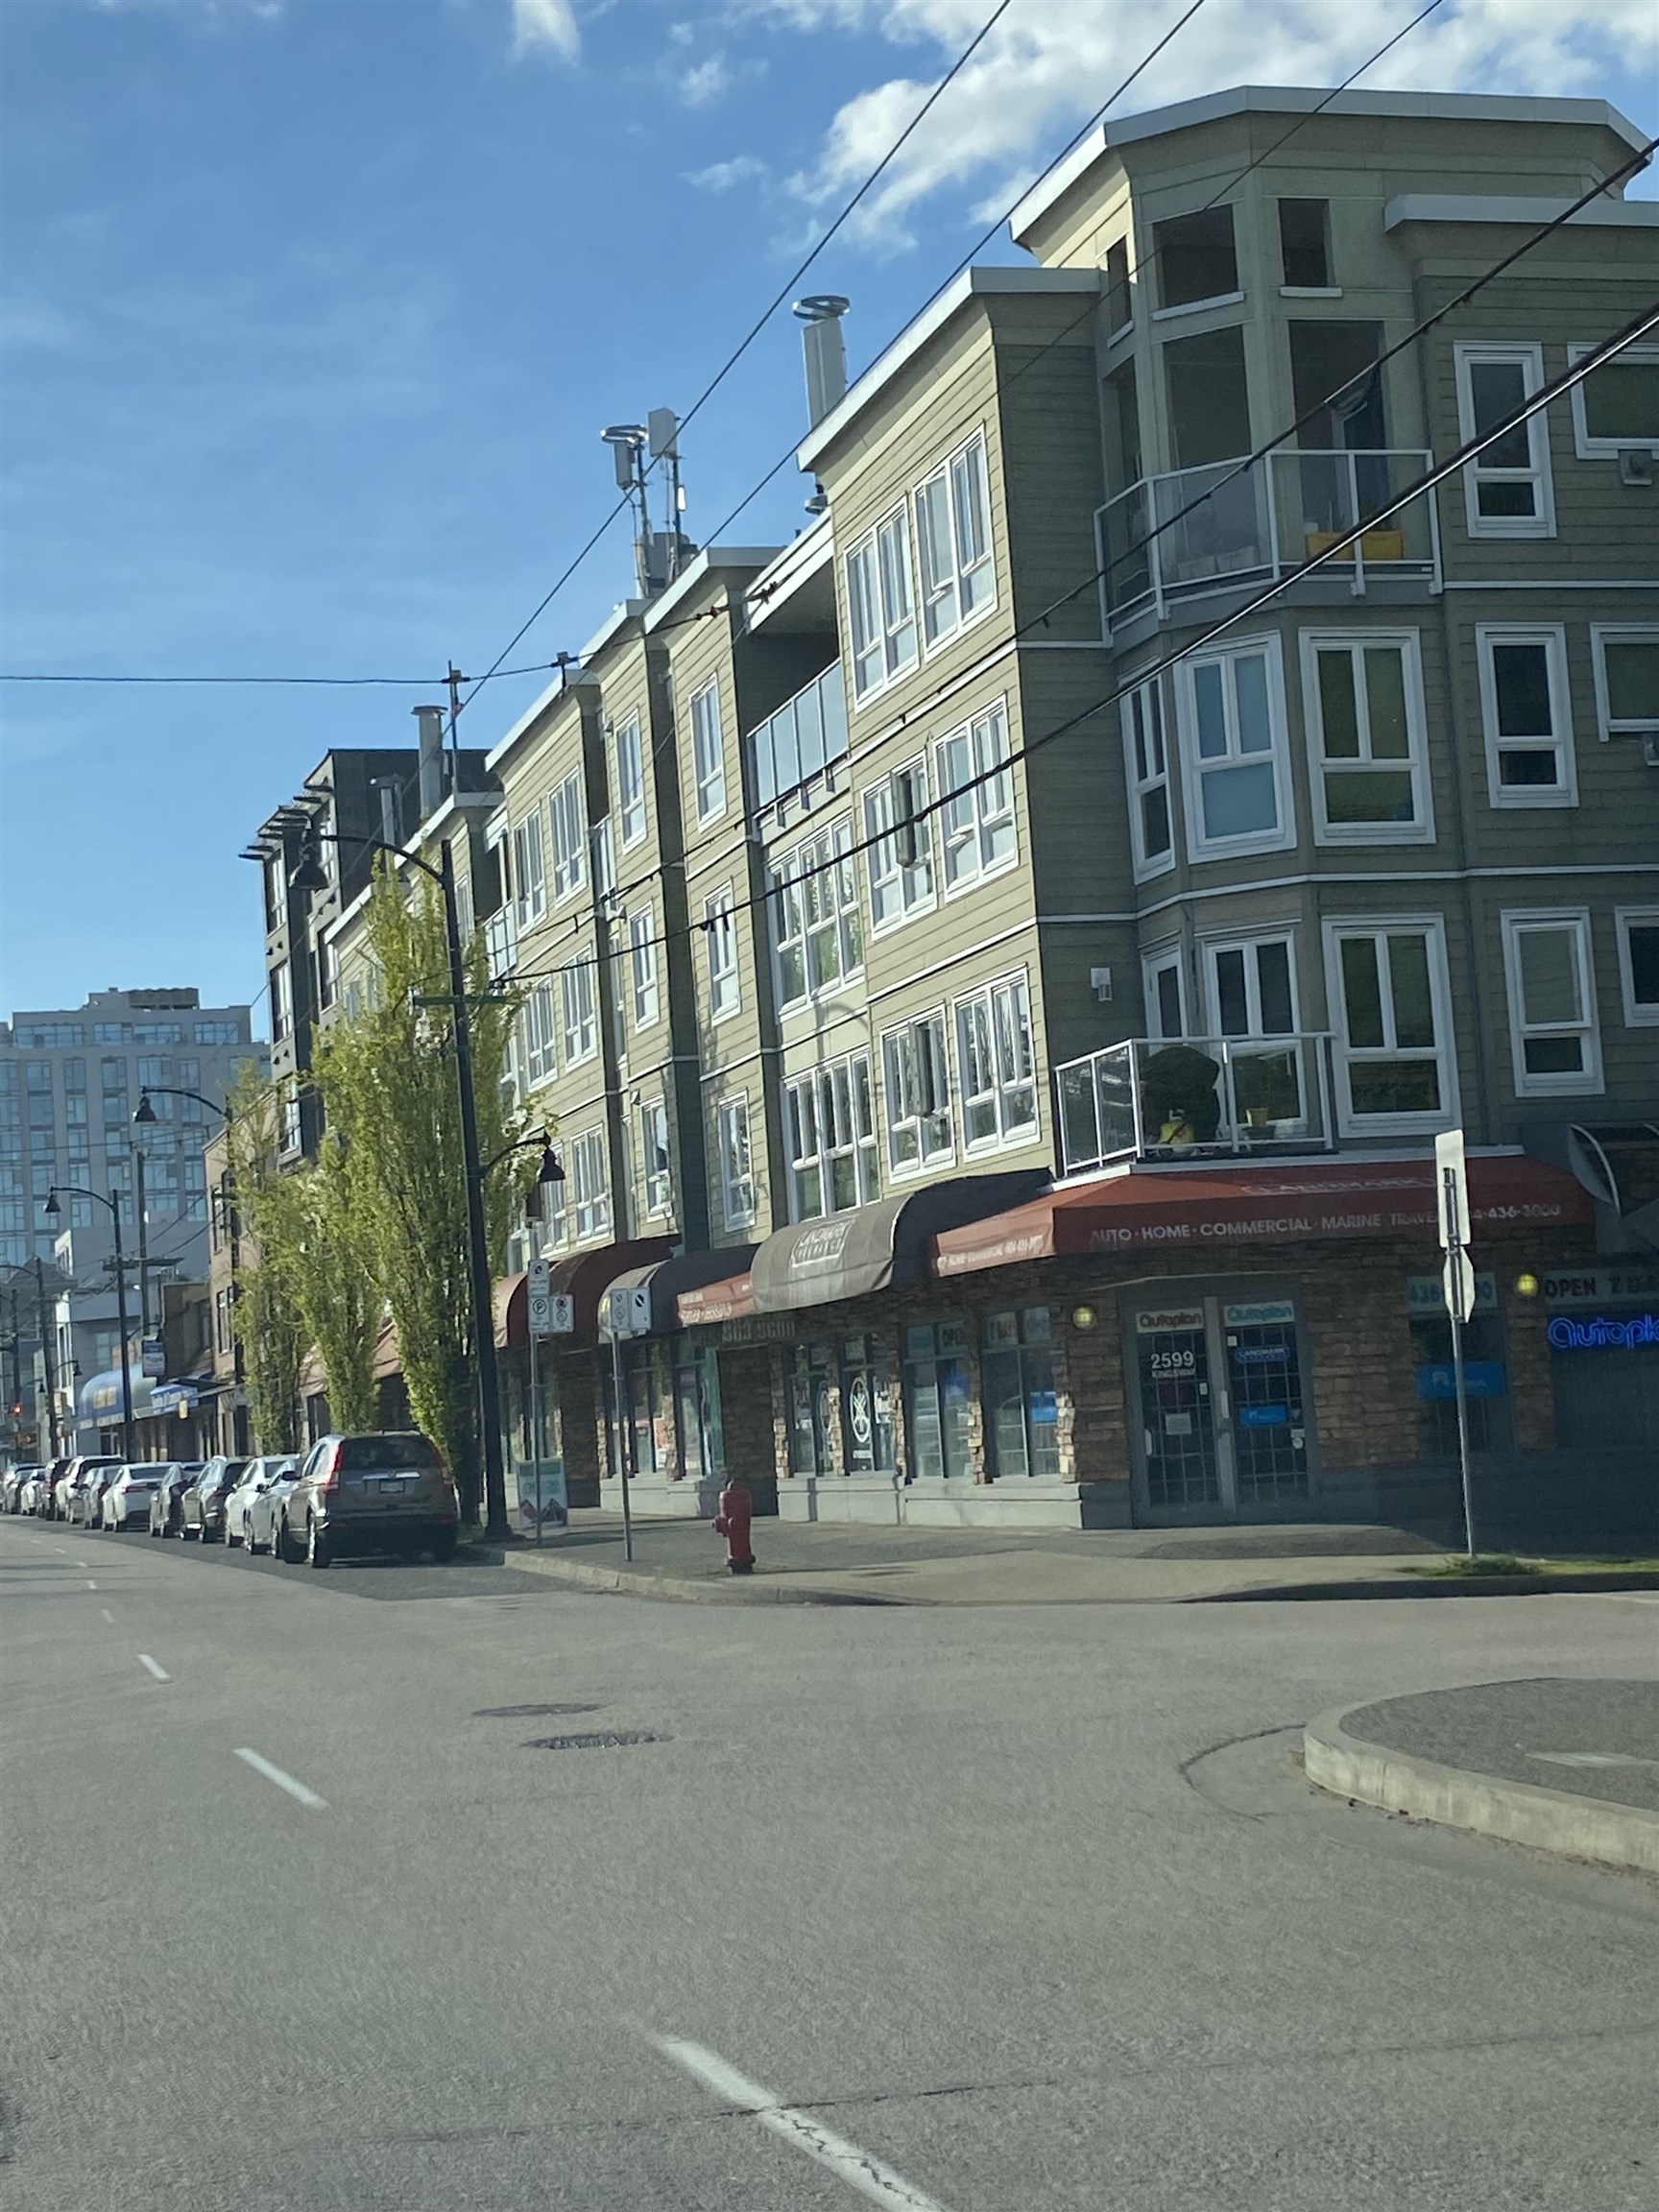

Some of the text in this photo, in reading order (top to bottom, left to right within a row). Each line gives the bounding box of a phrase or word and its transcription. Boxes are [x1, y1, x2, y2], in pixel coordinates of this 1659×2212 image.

[1091, 1228, 1132, 1243] AUTO
[1142, 1224, 1190, 1239] HOME
[1199, 1217, 1312, 1238] COMMERCIAL
[1321, 1214, 1382, 1230] MARINE
[1389, 1211, 1437, 1226] TRAVE
[1545, 1278, 1597, 1298] OPEN
[1151, 1351, 1194, 1369] 2599
